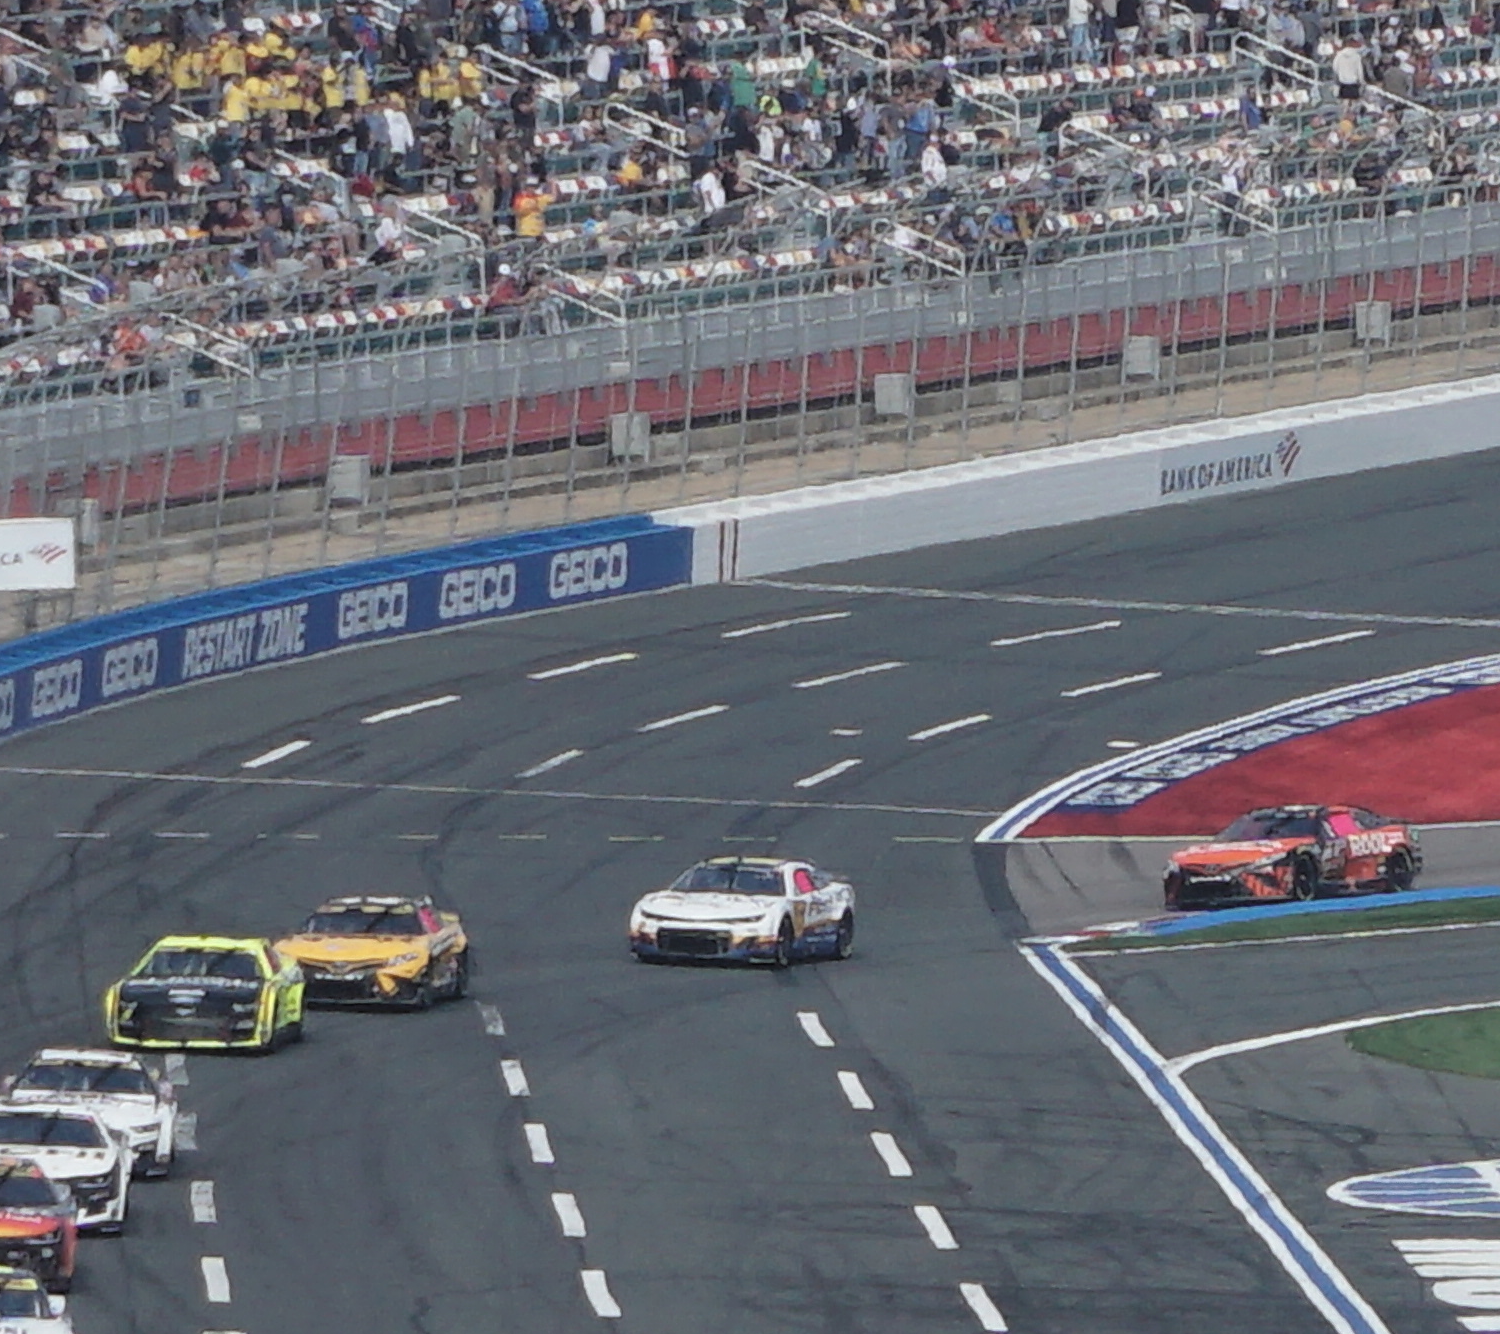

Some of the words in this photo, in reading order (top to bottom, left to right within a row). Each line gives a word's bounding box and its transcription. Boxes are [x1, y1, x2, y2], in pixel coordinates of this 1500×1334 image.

[1160, 465, 1195, 495] BANK
[1197, 462, 1215, 489] OF
[1215, 453, 1273, 486] AMERICA
[32, 660, 82, 717] GEICO
[101, 638, 158, 696] GEICO
[181, 612, 255, 680] RESTART
[256, 602, 307, 661] ZONE
[338, 582, 407, 639] GEICO
[440, 563, 516, 619] GEICO
[549, 542, 628, 599] GEICO
